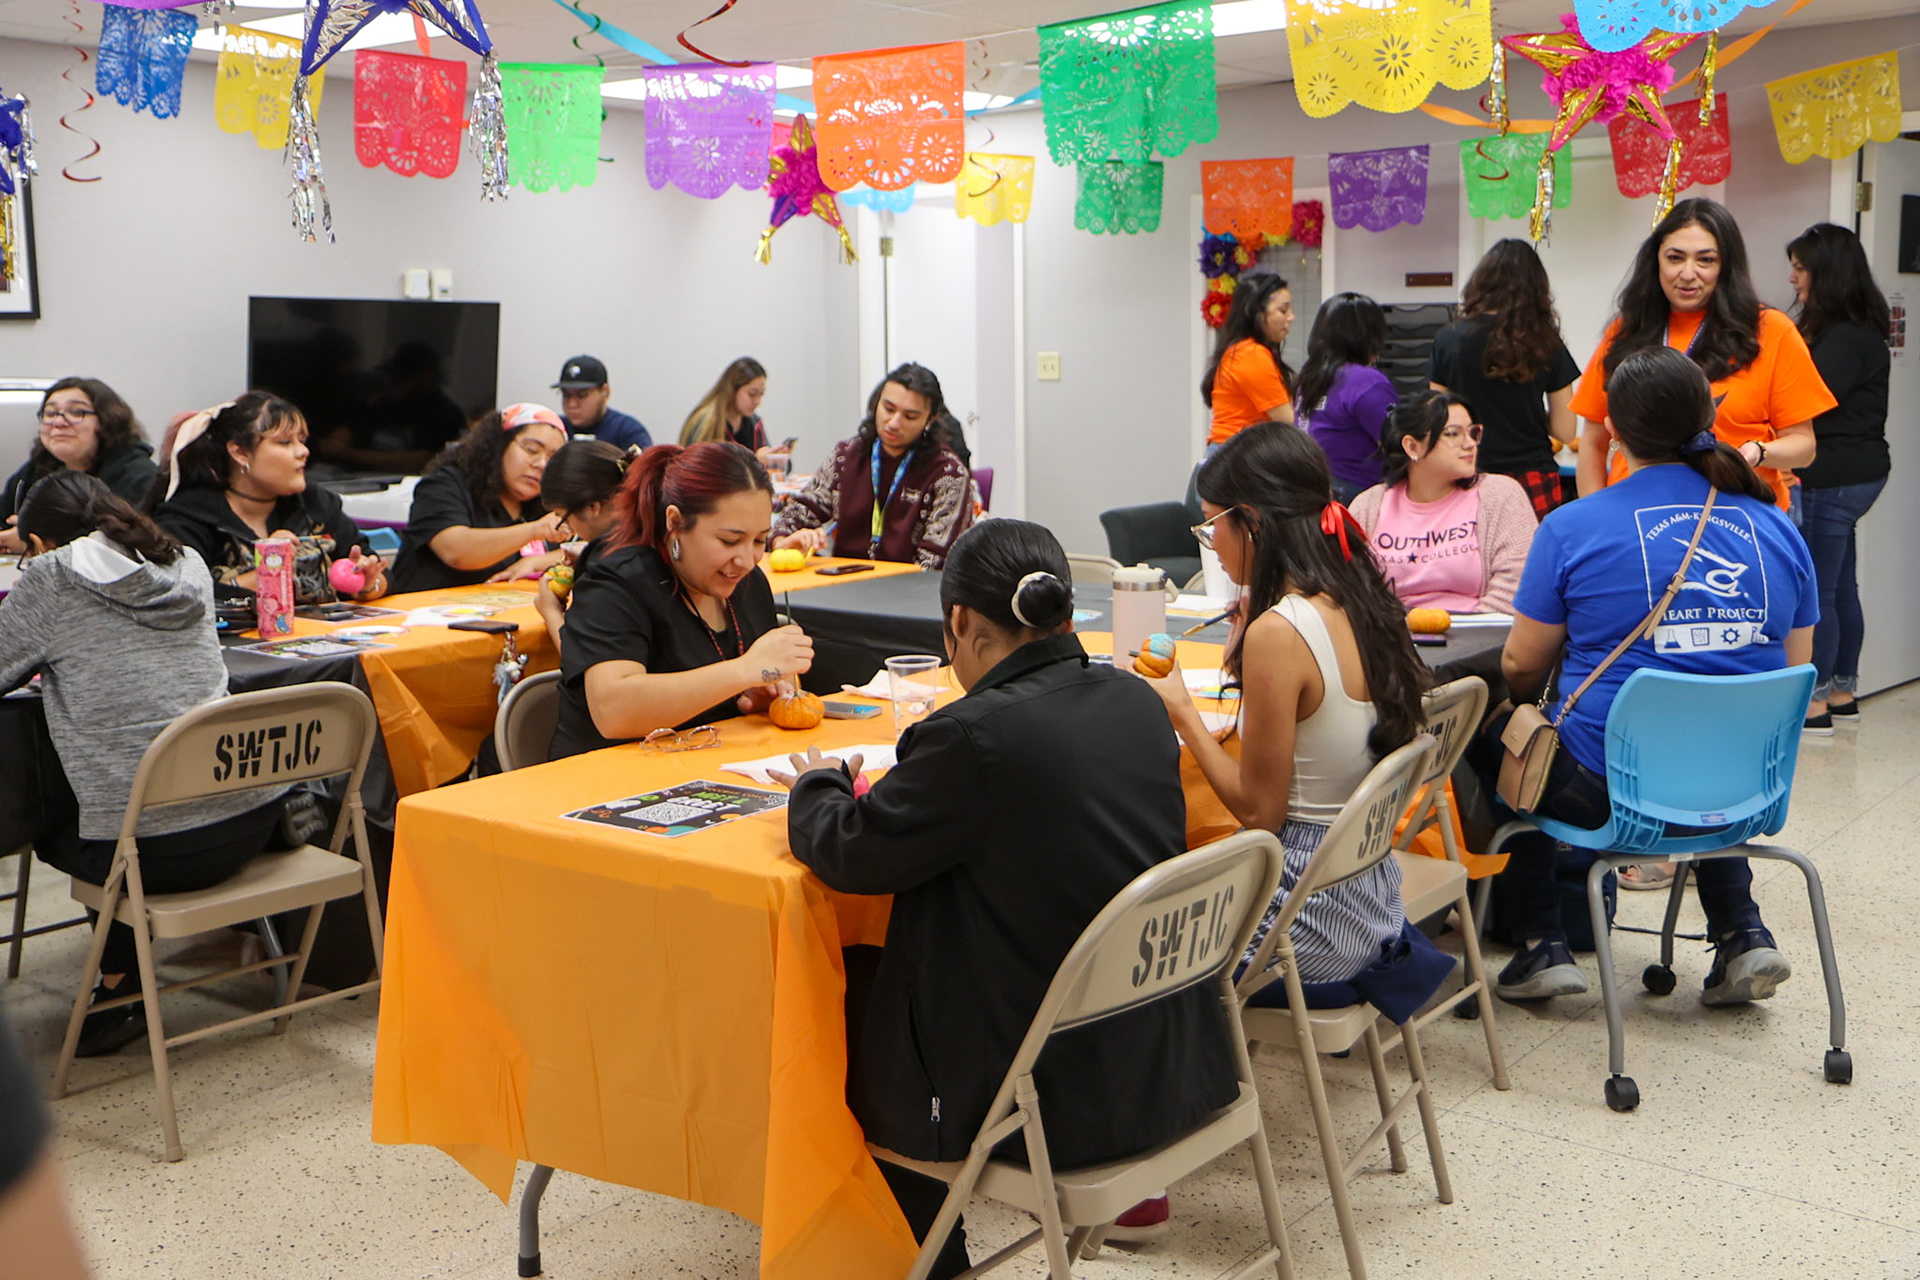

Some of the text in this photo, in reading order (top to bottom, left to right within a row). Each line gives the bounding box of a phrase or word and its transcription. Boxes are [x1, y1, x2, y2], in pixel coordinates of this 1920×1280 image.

[1375, 520, 1478, 551] OUTHWEST
[1645, 512, 1752, 542] TEXAS A&M-KNGSVILLE
[1379, 543, 1476, 564] XAS COLLEGE
[213, 719, 322, 782] SWTJC
[1131, 884, 1234, 988] SWTJC
